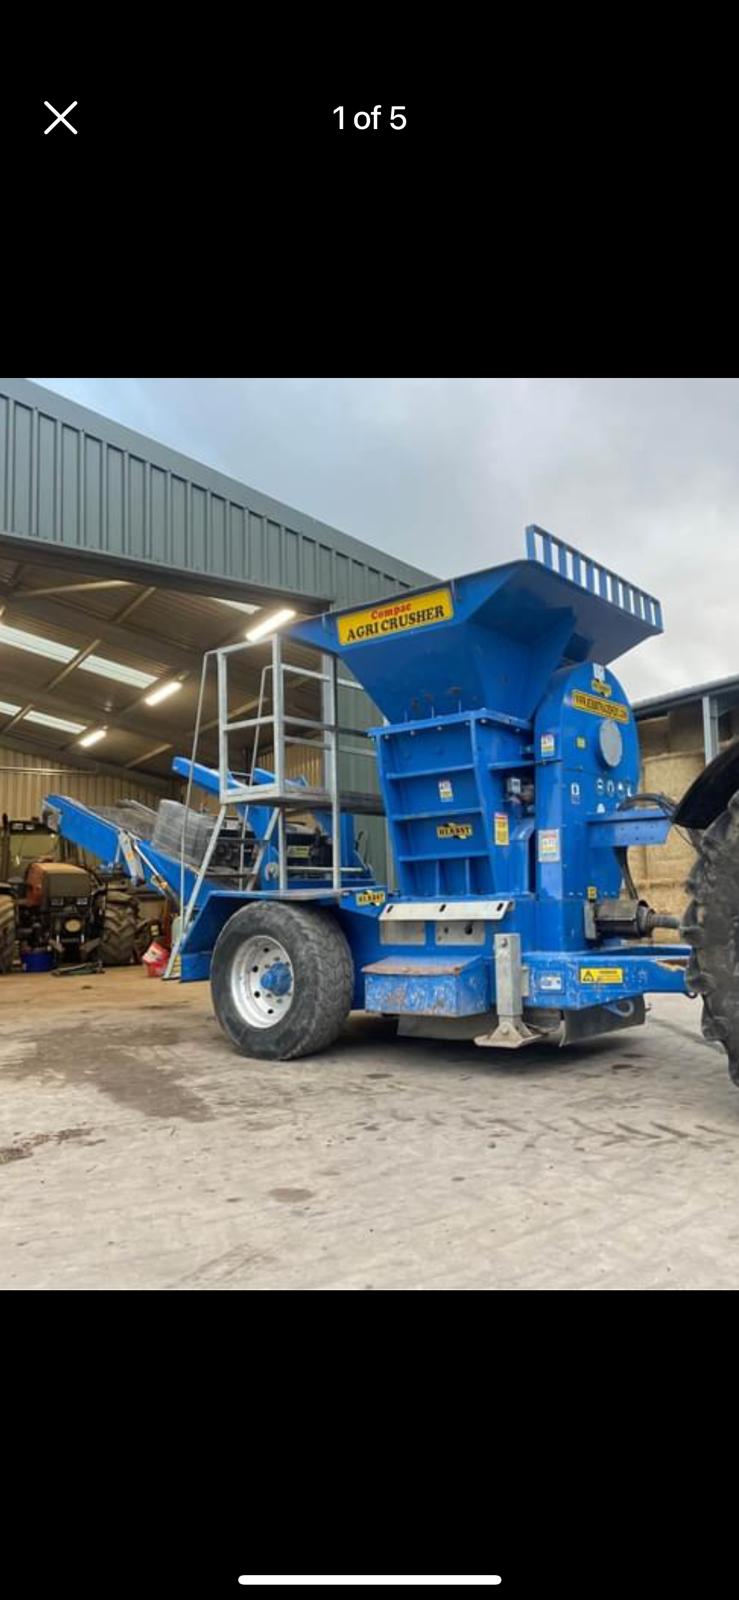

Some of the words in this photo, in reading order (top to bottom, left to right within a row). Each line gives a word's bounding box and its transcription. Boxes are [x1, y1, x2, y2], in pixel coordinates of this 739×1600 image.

[346, 621, 380, 642] AGRI
[380, 604, 445, 632] CRUSHER
[371, 603, 413, 620] Compac
